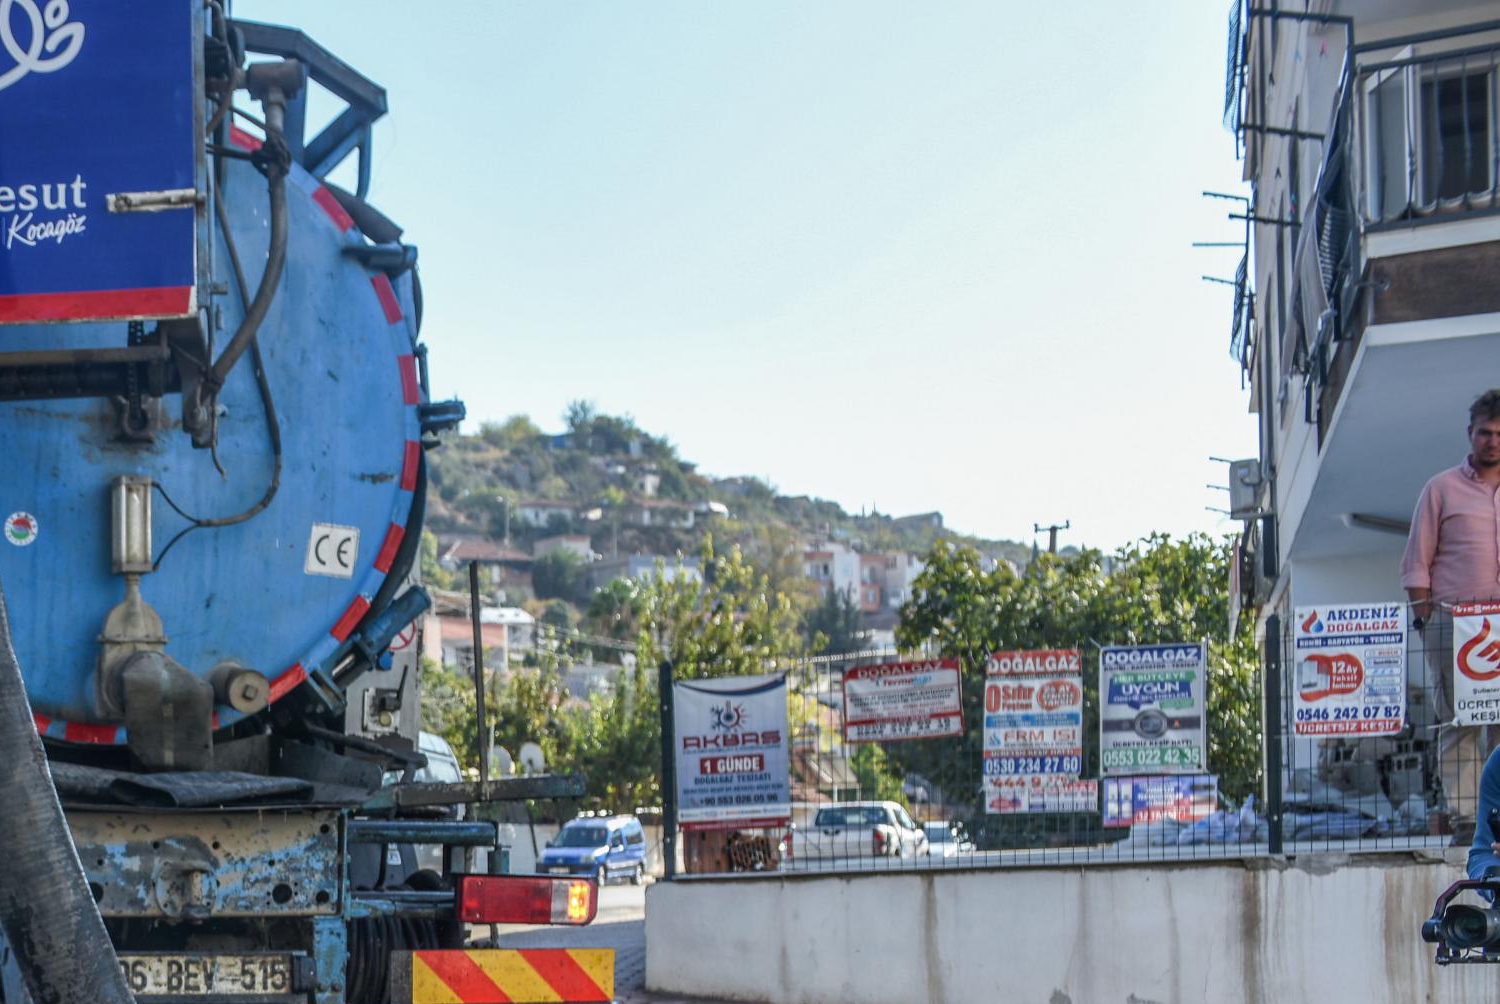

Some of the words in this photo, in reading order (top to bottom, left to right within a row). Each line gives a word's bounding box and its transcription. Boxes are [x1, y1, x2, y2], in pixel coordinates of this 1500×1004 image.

[7, 212, 87, 249] Kocagöz
[314, 534, 352, 568] CE
[1327, 605, 1399, 621] AKDENİZ
[1327, 620, 1398, 633] DOĞALGAZ
[988, 655, 1080, 673] DOĞALGAZ
[1106, 648, 1198, 664] DOĞALGAZ
[1332, 661, 1345, 674] 12
[1122, 681, 1180, 695] UYGUN
[1297, 708, 1330, 720] 0546
[1334, 707, 1359, 719] 242
[1363, 706, 1380, 718] 07
[1384, 705, 1401, 717] 82
[1300, 720, 1358, 734] ÜCRETSİZ
[703, 760, 712, 773] 1
[717, 756, 761, 773] GÜNDE
[986, 758, 1016, 773] 0530
[1019, 757, 1041, 773] 234
[1044, 757, 1060, 772] 27
[1063, 756, 1079, 772] 60
[1103, 750, 1134, 766] 0553
[1138, 749, 1161, 765] 022
[1164, 748, 1181, 764] 42
[1184, 747, 1200, 764] 35
[240, 958, 287, 992] 515
